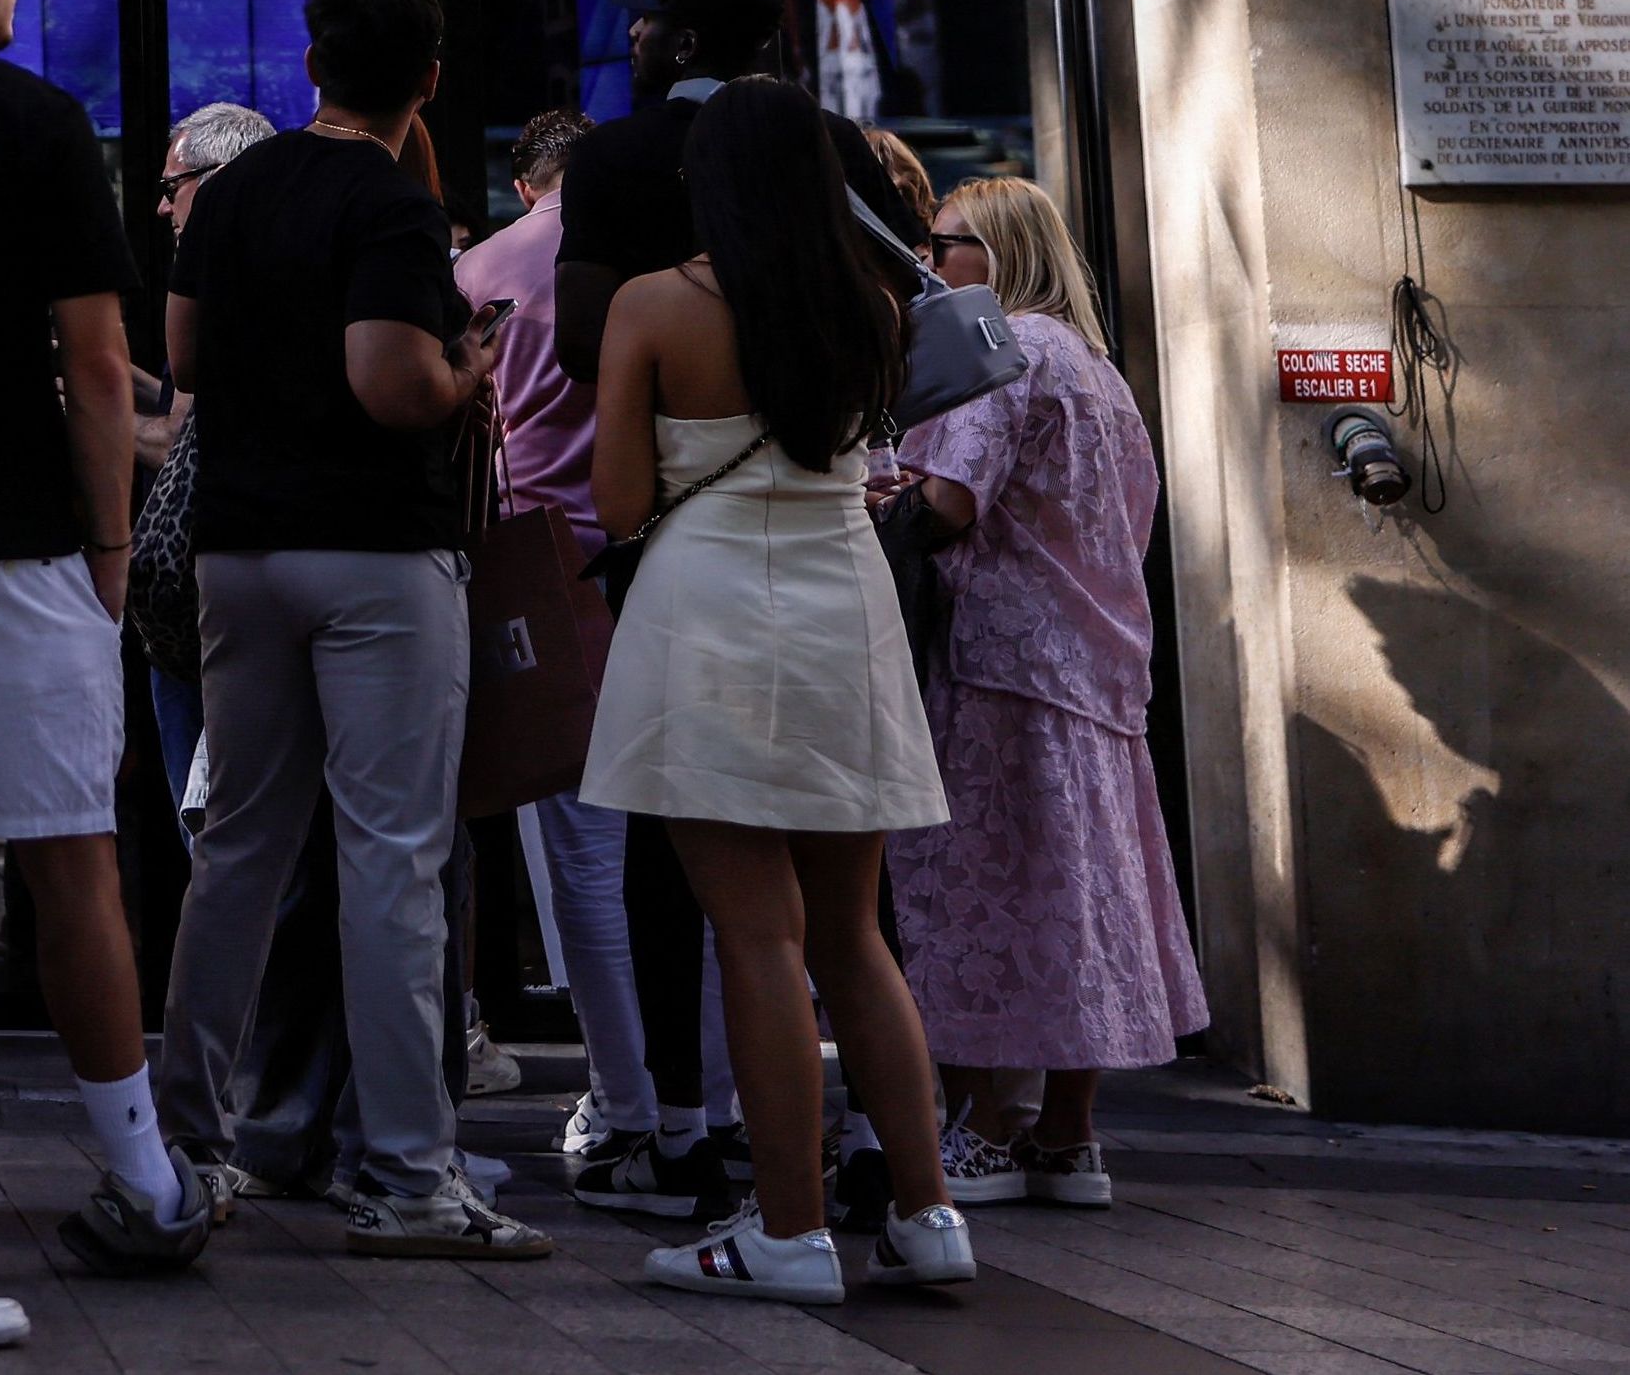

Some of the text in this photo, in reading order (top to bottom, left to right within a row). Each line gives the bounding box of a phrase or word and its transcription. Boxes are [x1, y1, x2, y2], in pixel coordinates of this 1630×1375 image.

[1553, 14, 1571, 27] DE
[1426, 38, 1471, 53] CETTE
[1511, 55, 1553, 68] AVRIL
[1424, 71, 1450, 84] PAR
[1456, 71, 1479, 84] LES
[1484, 71, 1528, 84] SOINS
[1531, 71, 1556, 84] DES
[1423, 101, 1486, 114] SOLDATS
[1494, 101, 1512, 114] DE
[1517, 101, 1535, 114] LA
[1469, 121, 1489, 134] EN
[1437, 138, 1456, 150] DU
[1459, 137, 1544, 150] CENTENAIRE
[1282, 353, 1386, 372] COLONNE SECHE
[1294, 378, 1355, 397] ESCALIER
